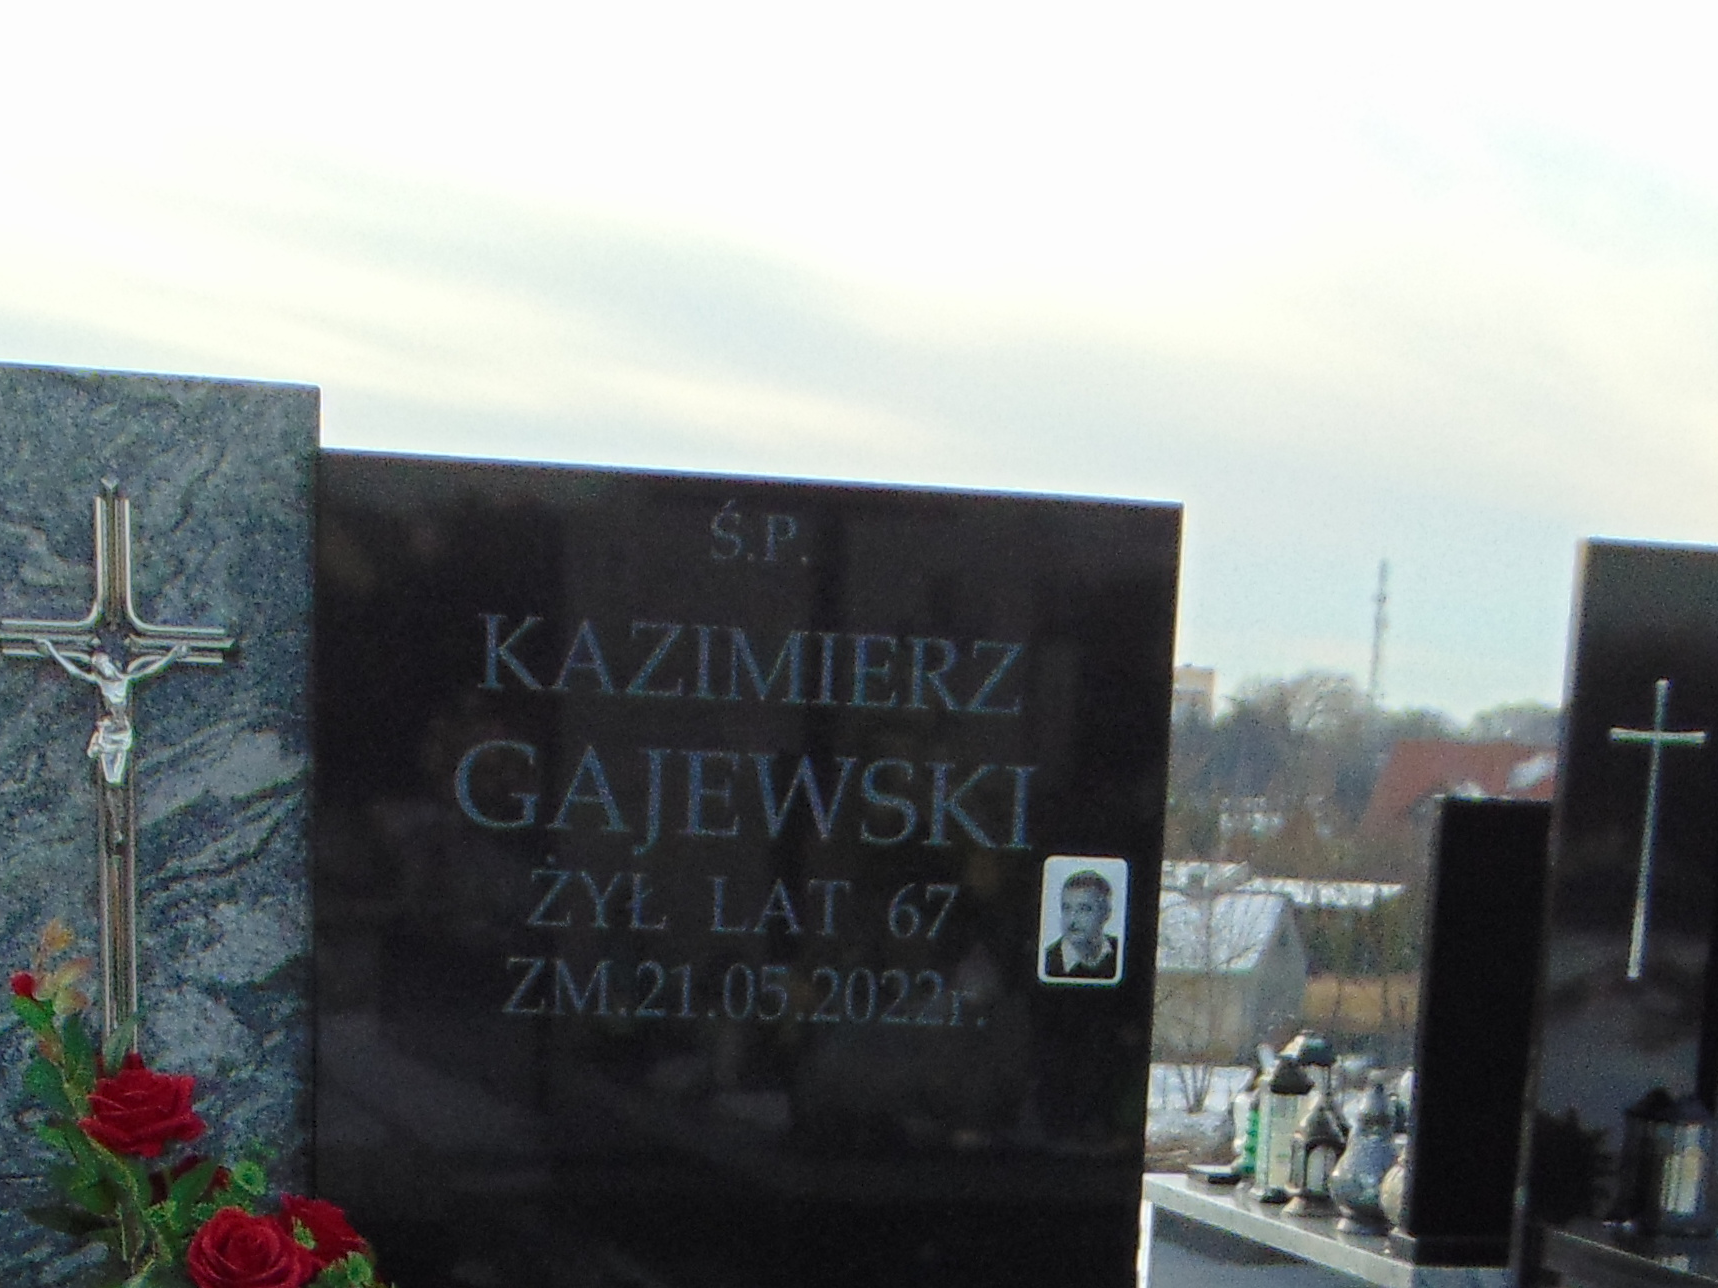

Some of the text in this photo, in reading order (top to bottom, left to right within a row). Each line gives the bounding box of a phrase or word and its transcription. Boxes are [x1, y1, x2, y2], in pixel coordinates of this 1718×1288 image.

[709, 498, 809, 564] Ś.P.
[477, 612, 1025, 716] KAZIMIERZ
[453, 738, 1036, 856] GAJEWSKI
[526, 853, 970, 940] ŻYŁ LAT 67
